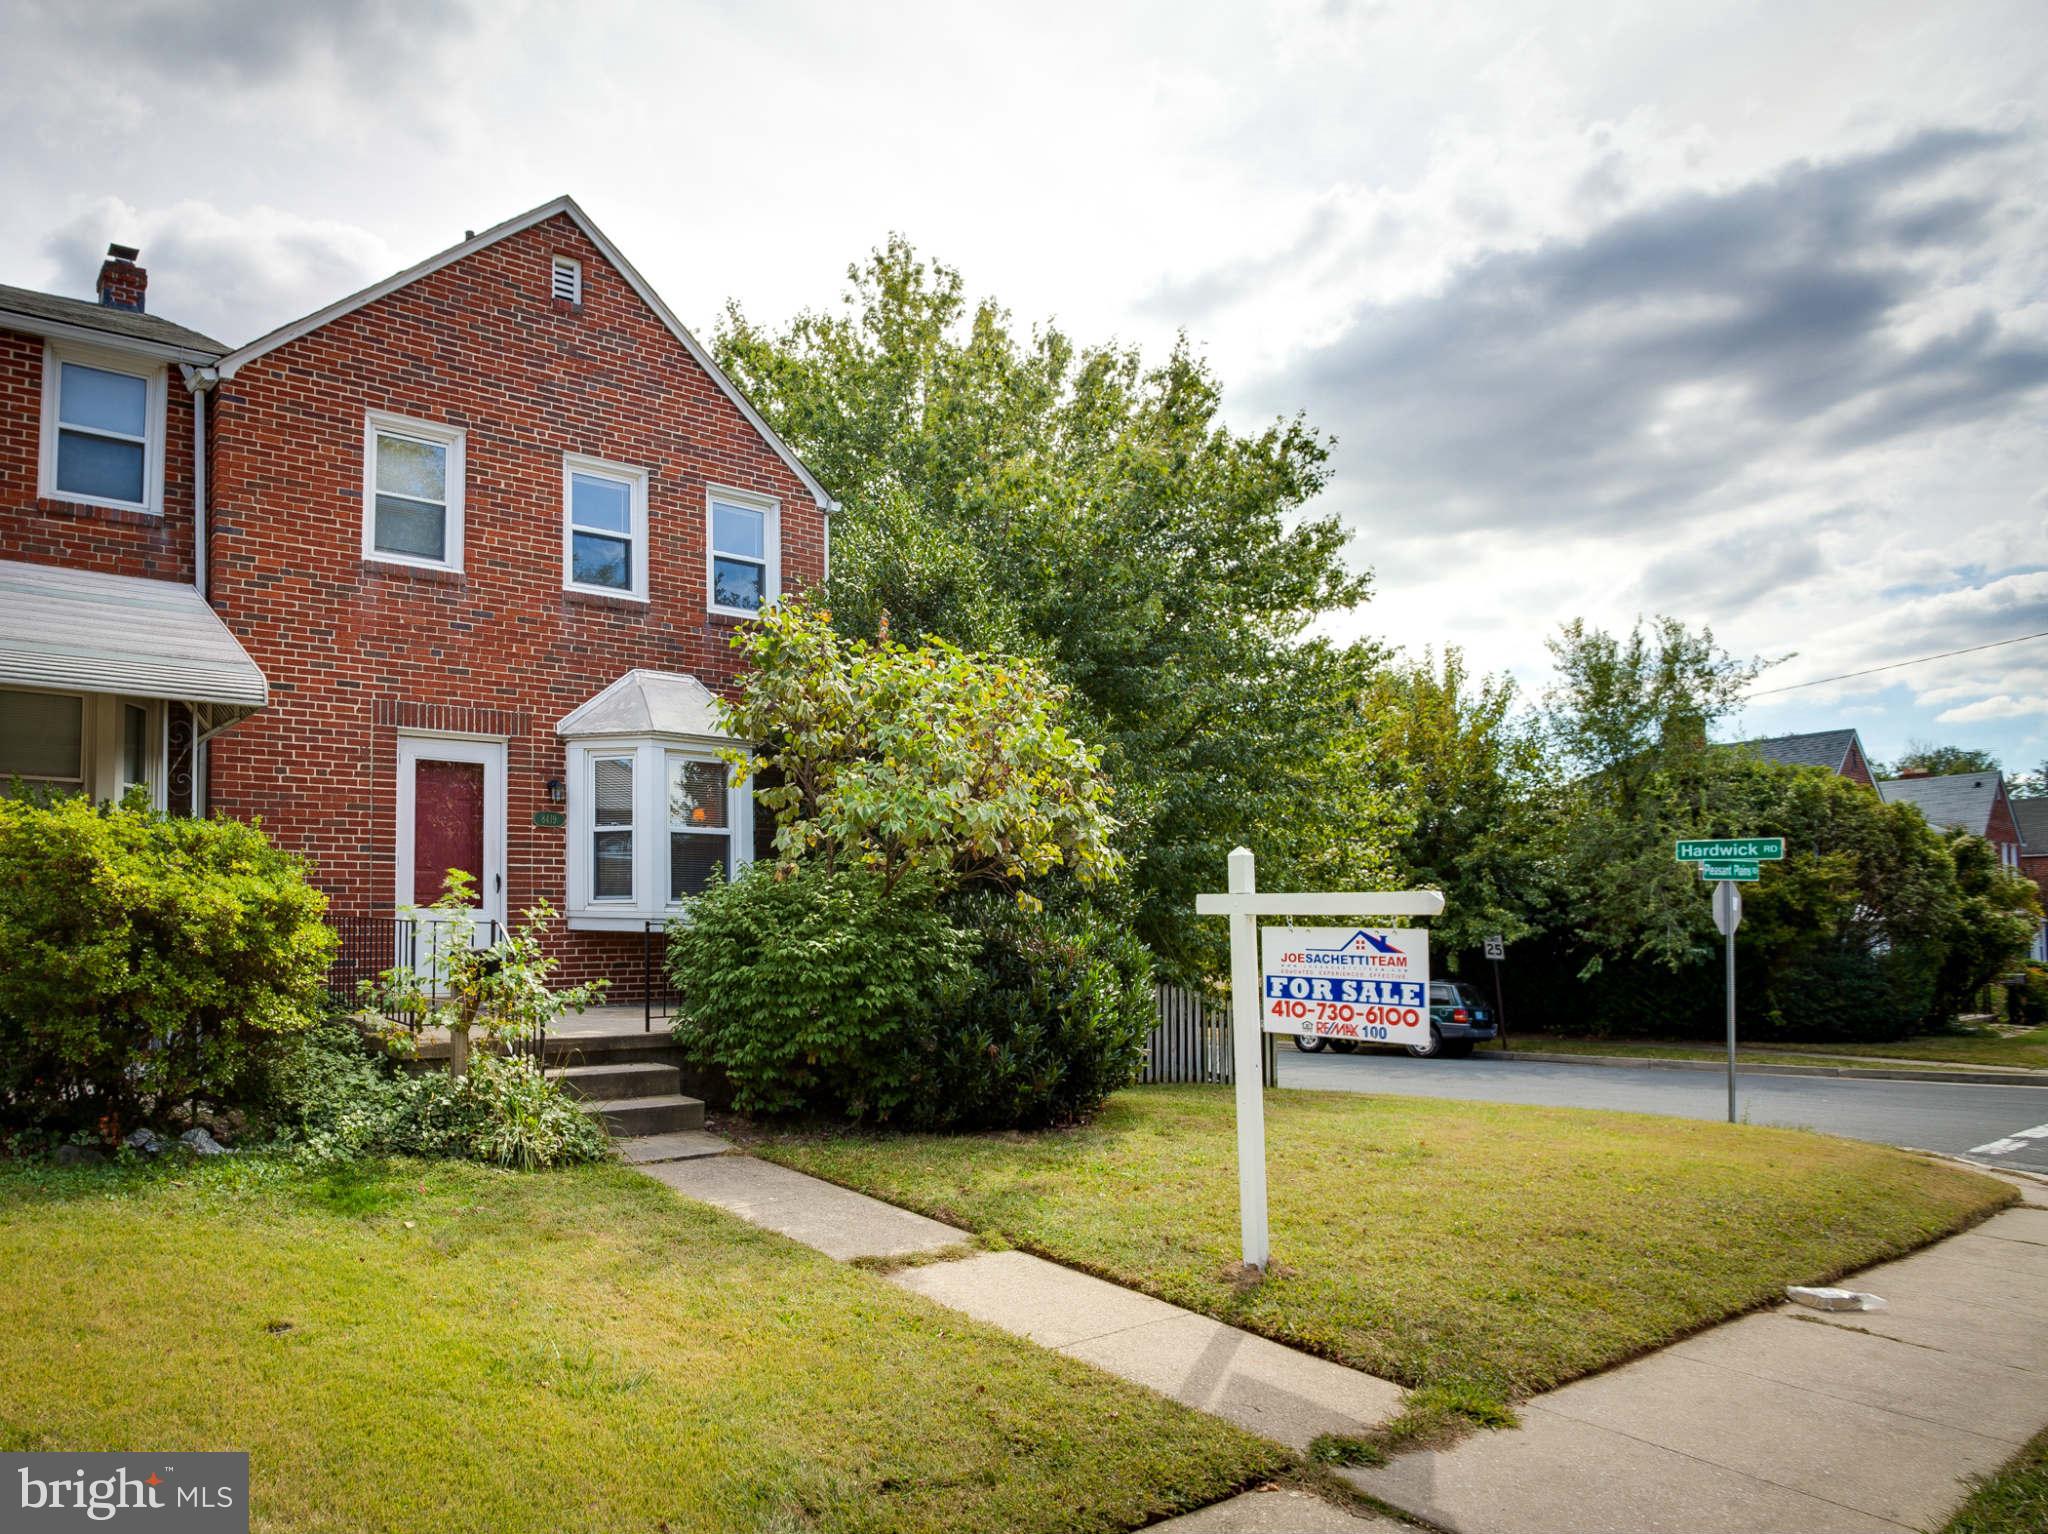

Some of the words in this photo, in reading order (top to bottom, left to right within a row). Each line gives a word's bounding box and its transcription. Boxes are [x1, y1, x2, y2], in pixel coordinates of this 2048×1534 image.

[1681, 843, 1758, 857] Hardwick
[1763, 844, 1778, 853] RD
[1487, 943, 1502, 955] 25
[1280, 952, 1407, 968] JOESACHETTITEAM
[1270, 977, 1333, 1001] FOR
[1342, 981, 1420, 1006] SALE
[1271, 1000, 1420, 1027] 410-730-6100
[1316, 1021, 1359, 1038] RE/MAX
[1362, 1025, 1388, 1040] 100
